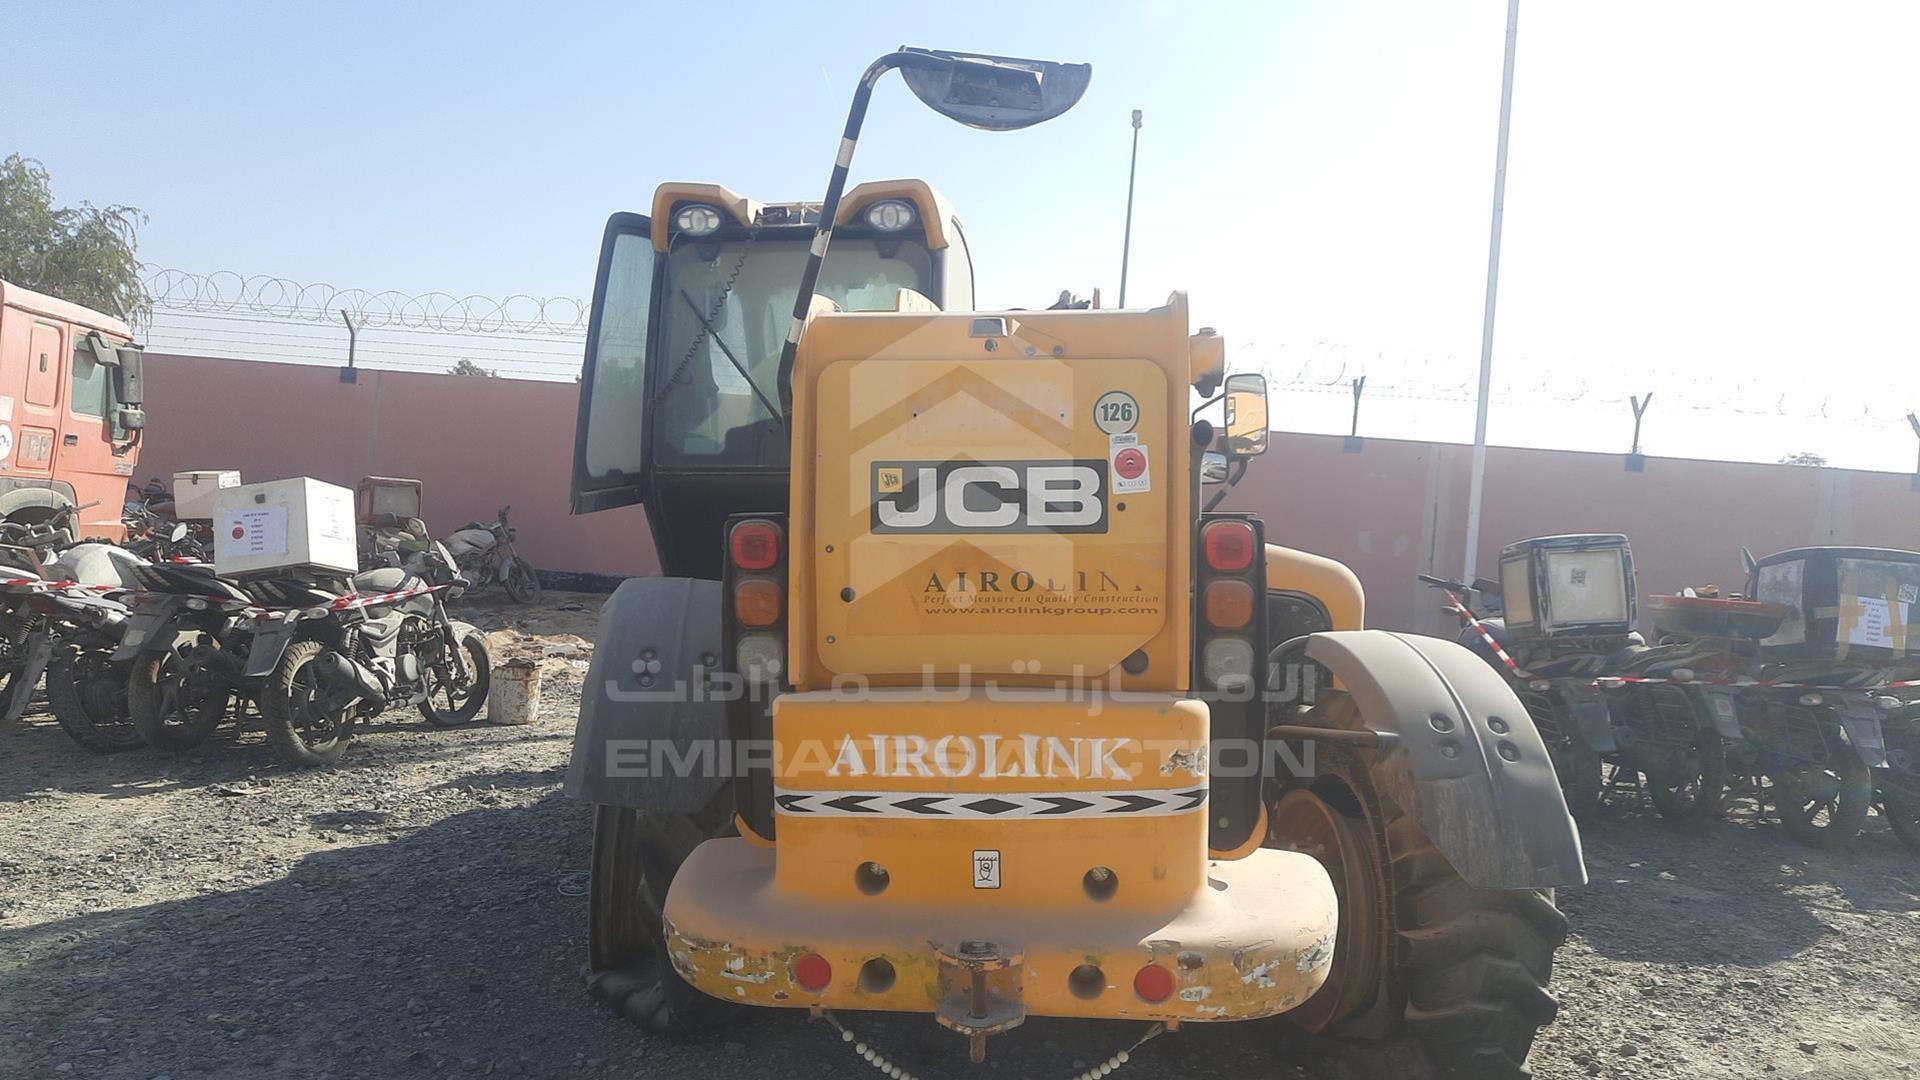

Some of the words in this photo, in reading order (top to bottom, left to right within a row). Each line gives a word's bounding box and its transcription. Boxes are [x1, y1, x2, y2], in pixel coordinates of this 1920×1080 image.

[1100, 402, 1133, 422] 126
[878, 466, 1102, 527] JCB
[924, 570, 1143, 593] AIROLIN
[925, 606, 1159, 616] www.airolinkgroup.com
[827, 733, 1133, 781] AIROLINK
